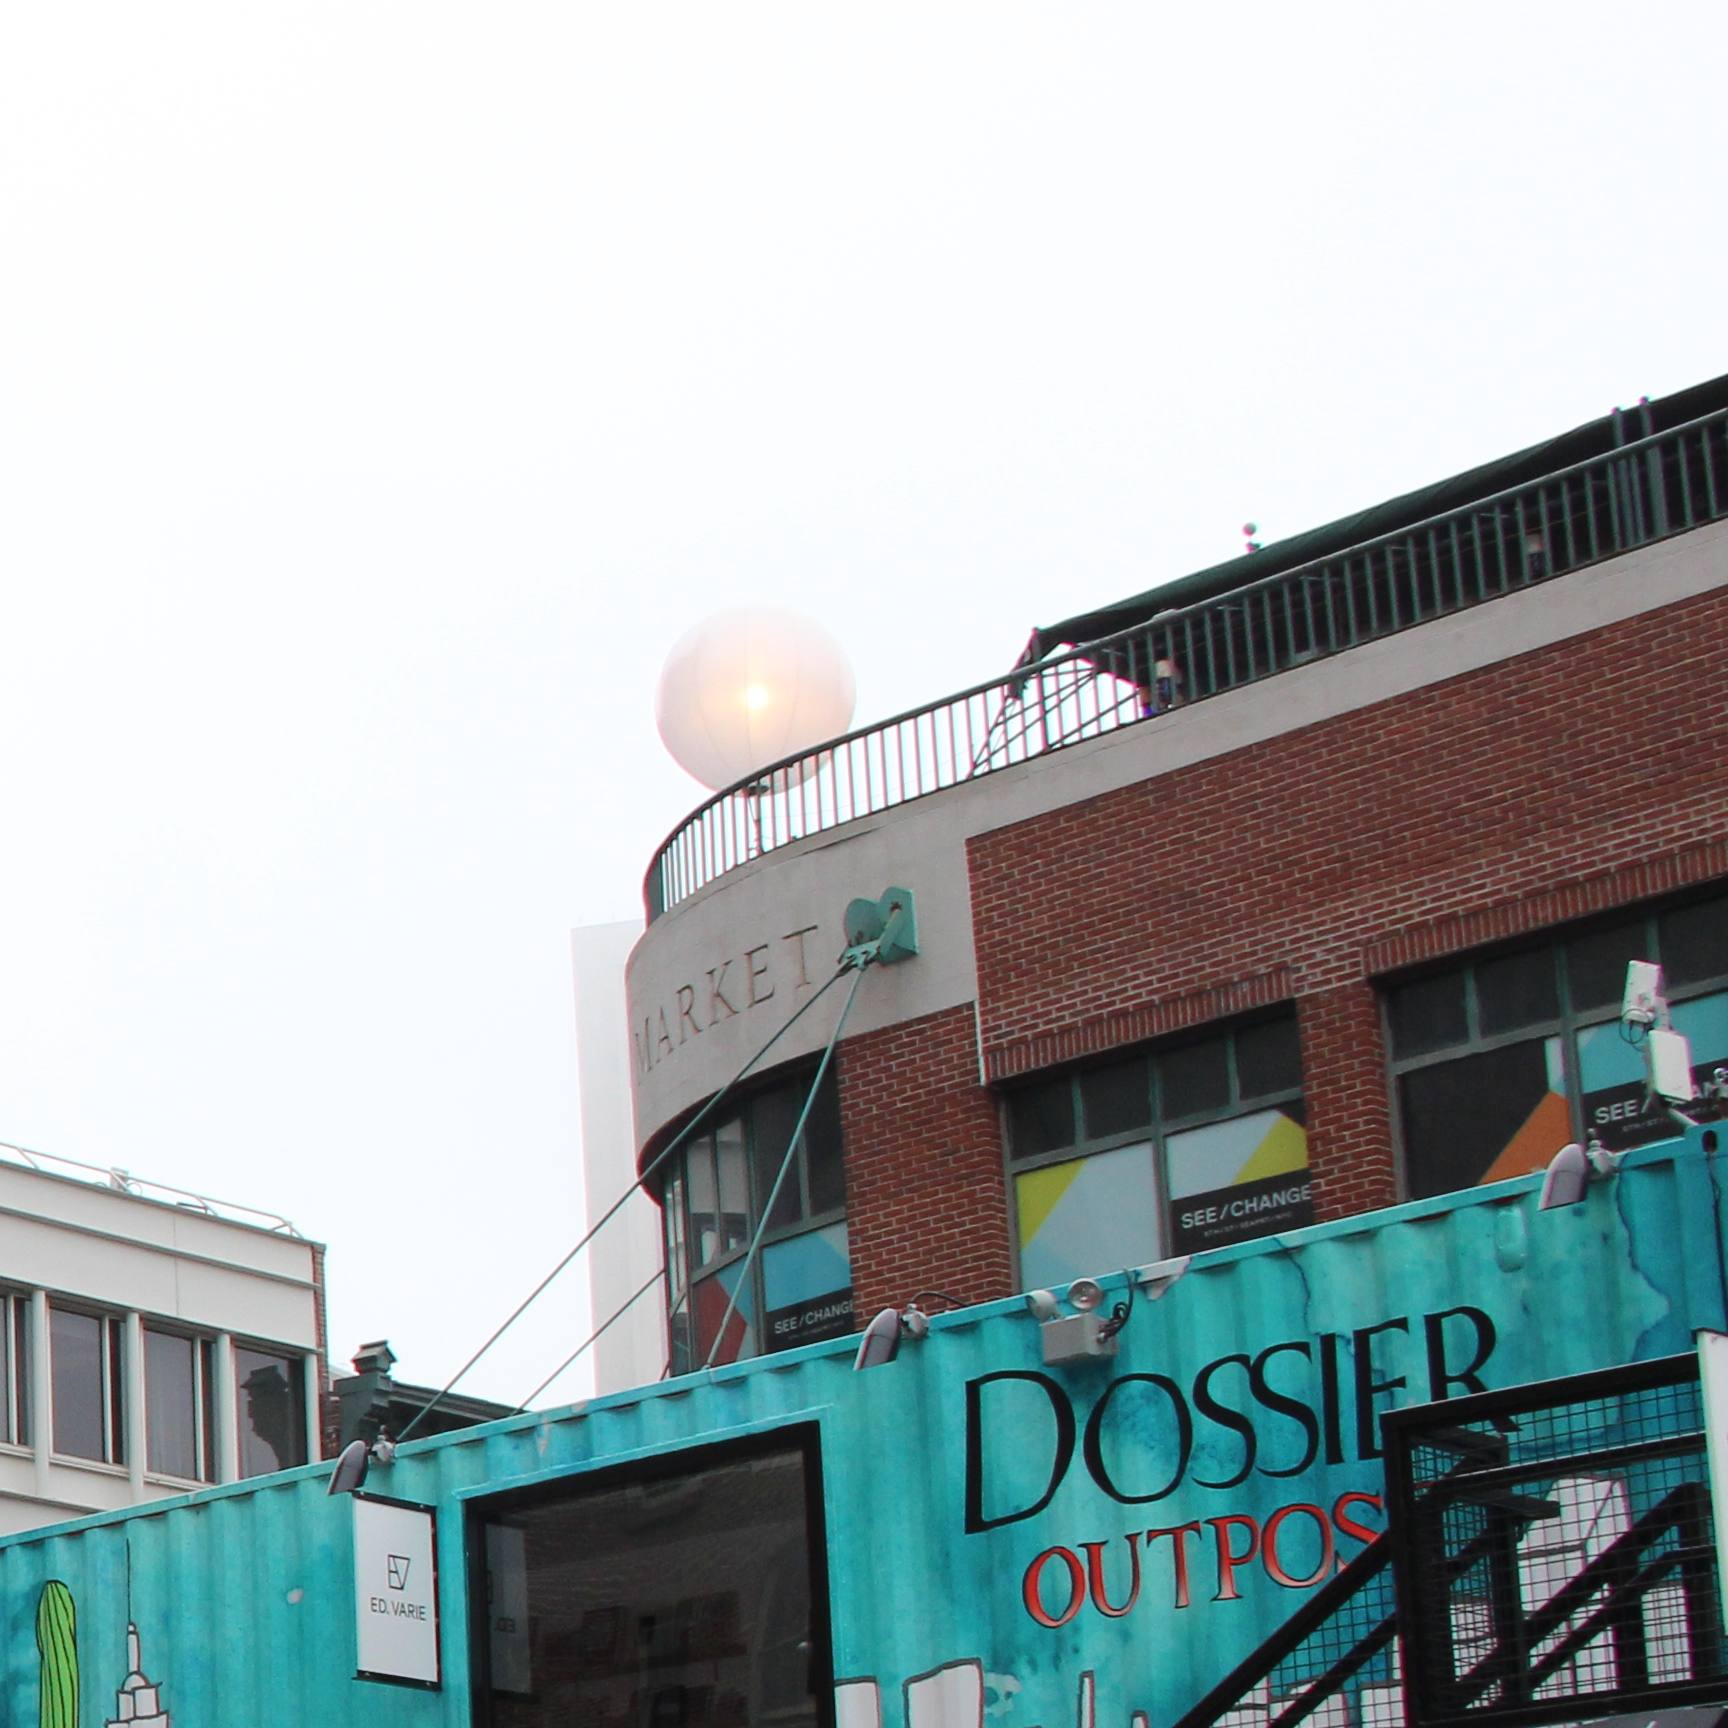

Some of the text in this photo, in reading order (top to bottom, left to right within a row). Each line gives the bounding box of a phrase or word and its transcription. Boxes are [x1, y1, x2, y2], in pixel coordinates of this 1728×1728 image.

[636, 925, 819, 1087] MARKET
[964, 1304, 1518, 1535] DOSSIER
[370, 1596, 427, 1622] ED. VARIE
[1021, 1489, 1392, 1629] OUTPOS
